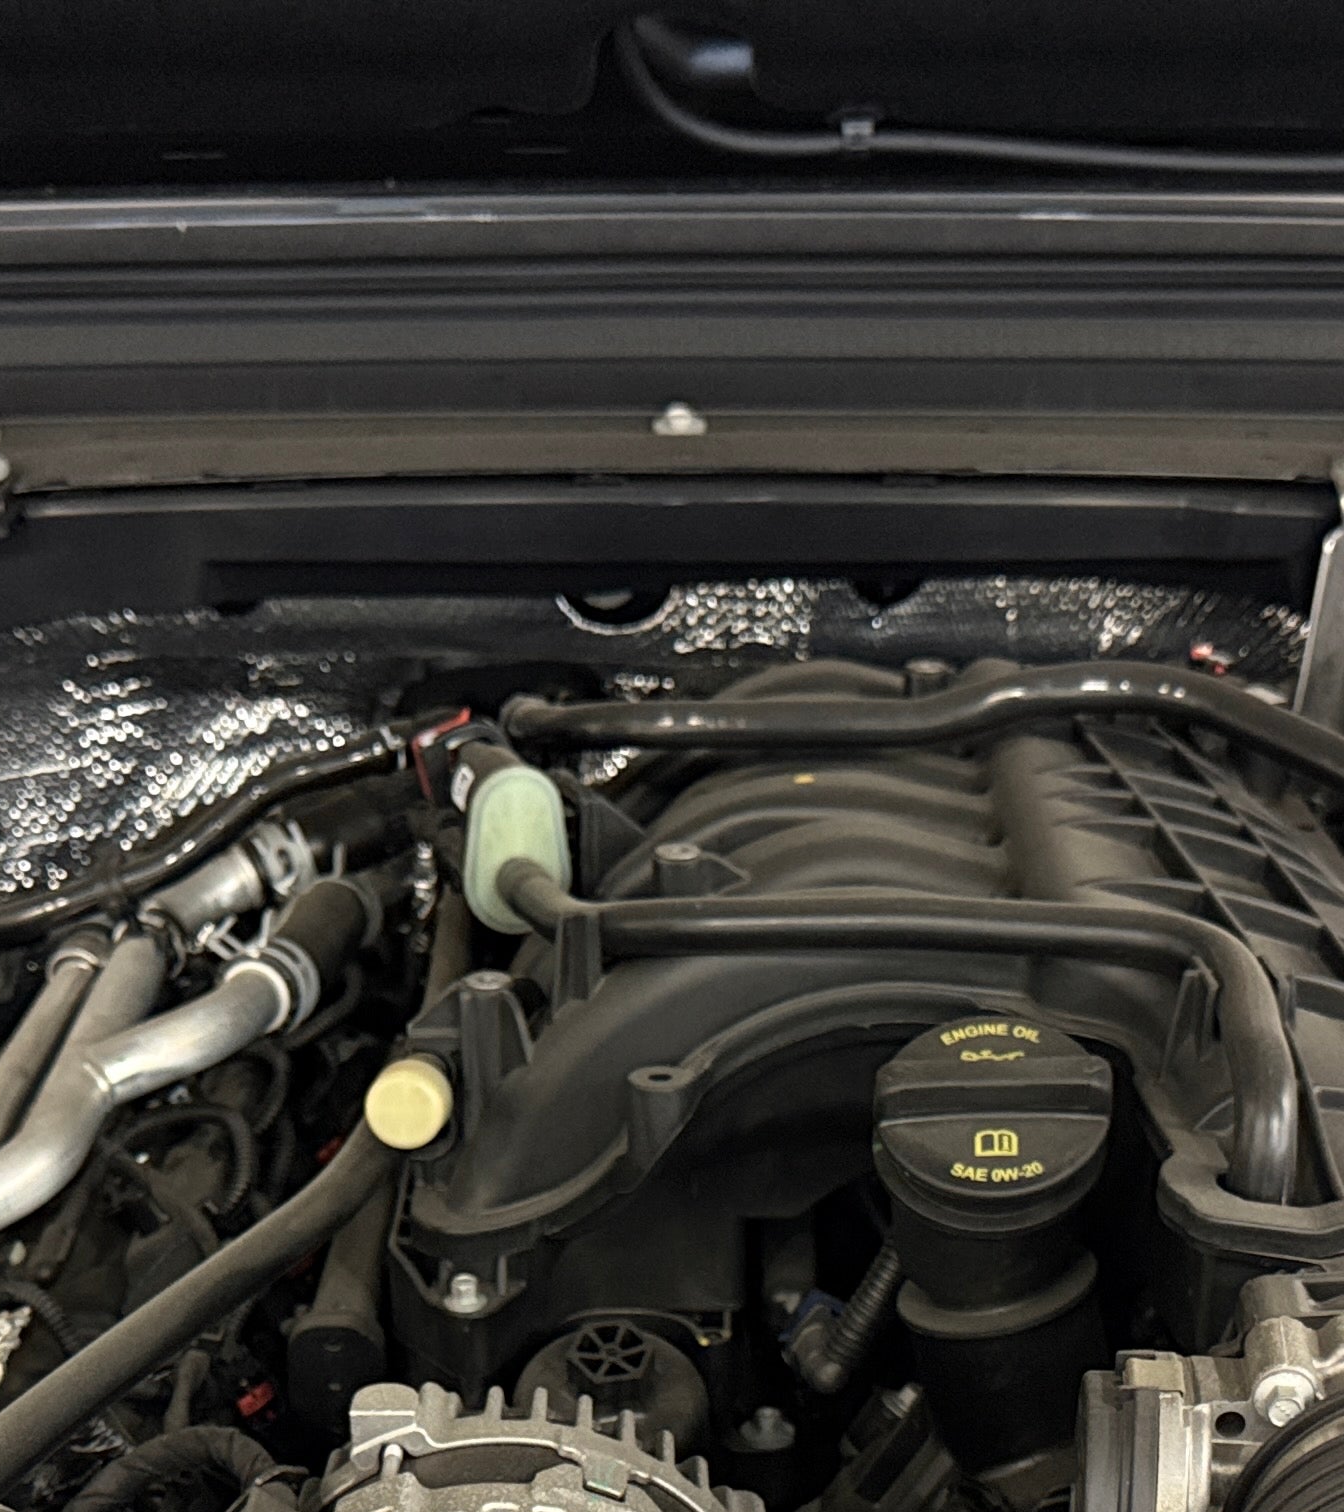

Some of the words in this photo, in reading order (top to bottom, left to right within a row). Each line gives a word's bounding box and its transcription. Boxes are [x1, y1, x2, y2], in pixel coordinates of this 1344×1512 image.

[940, 1023, 1008, 1046] ENGINE
[1012, 1025, 1040, 1044] OIL
[950, 1162, 988, 1182] SAE
[991, 1161, 1044, 1183] 0W-20
